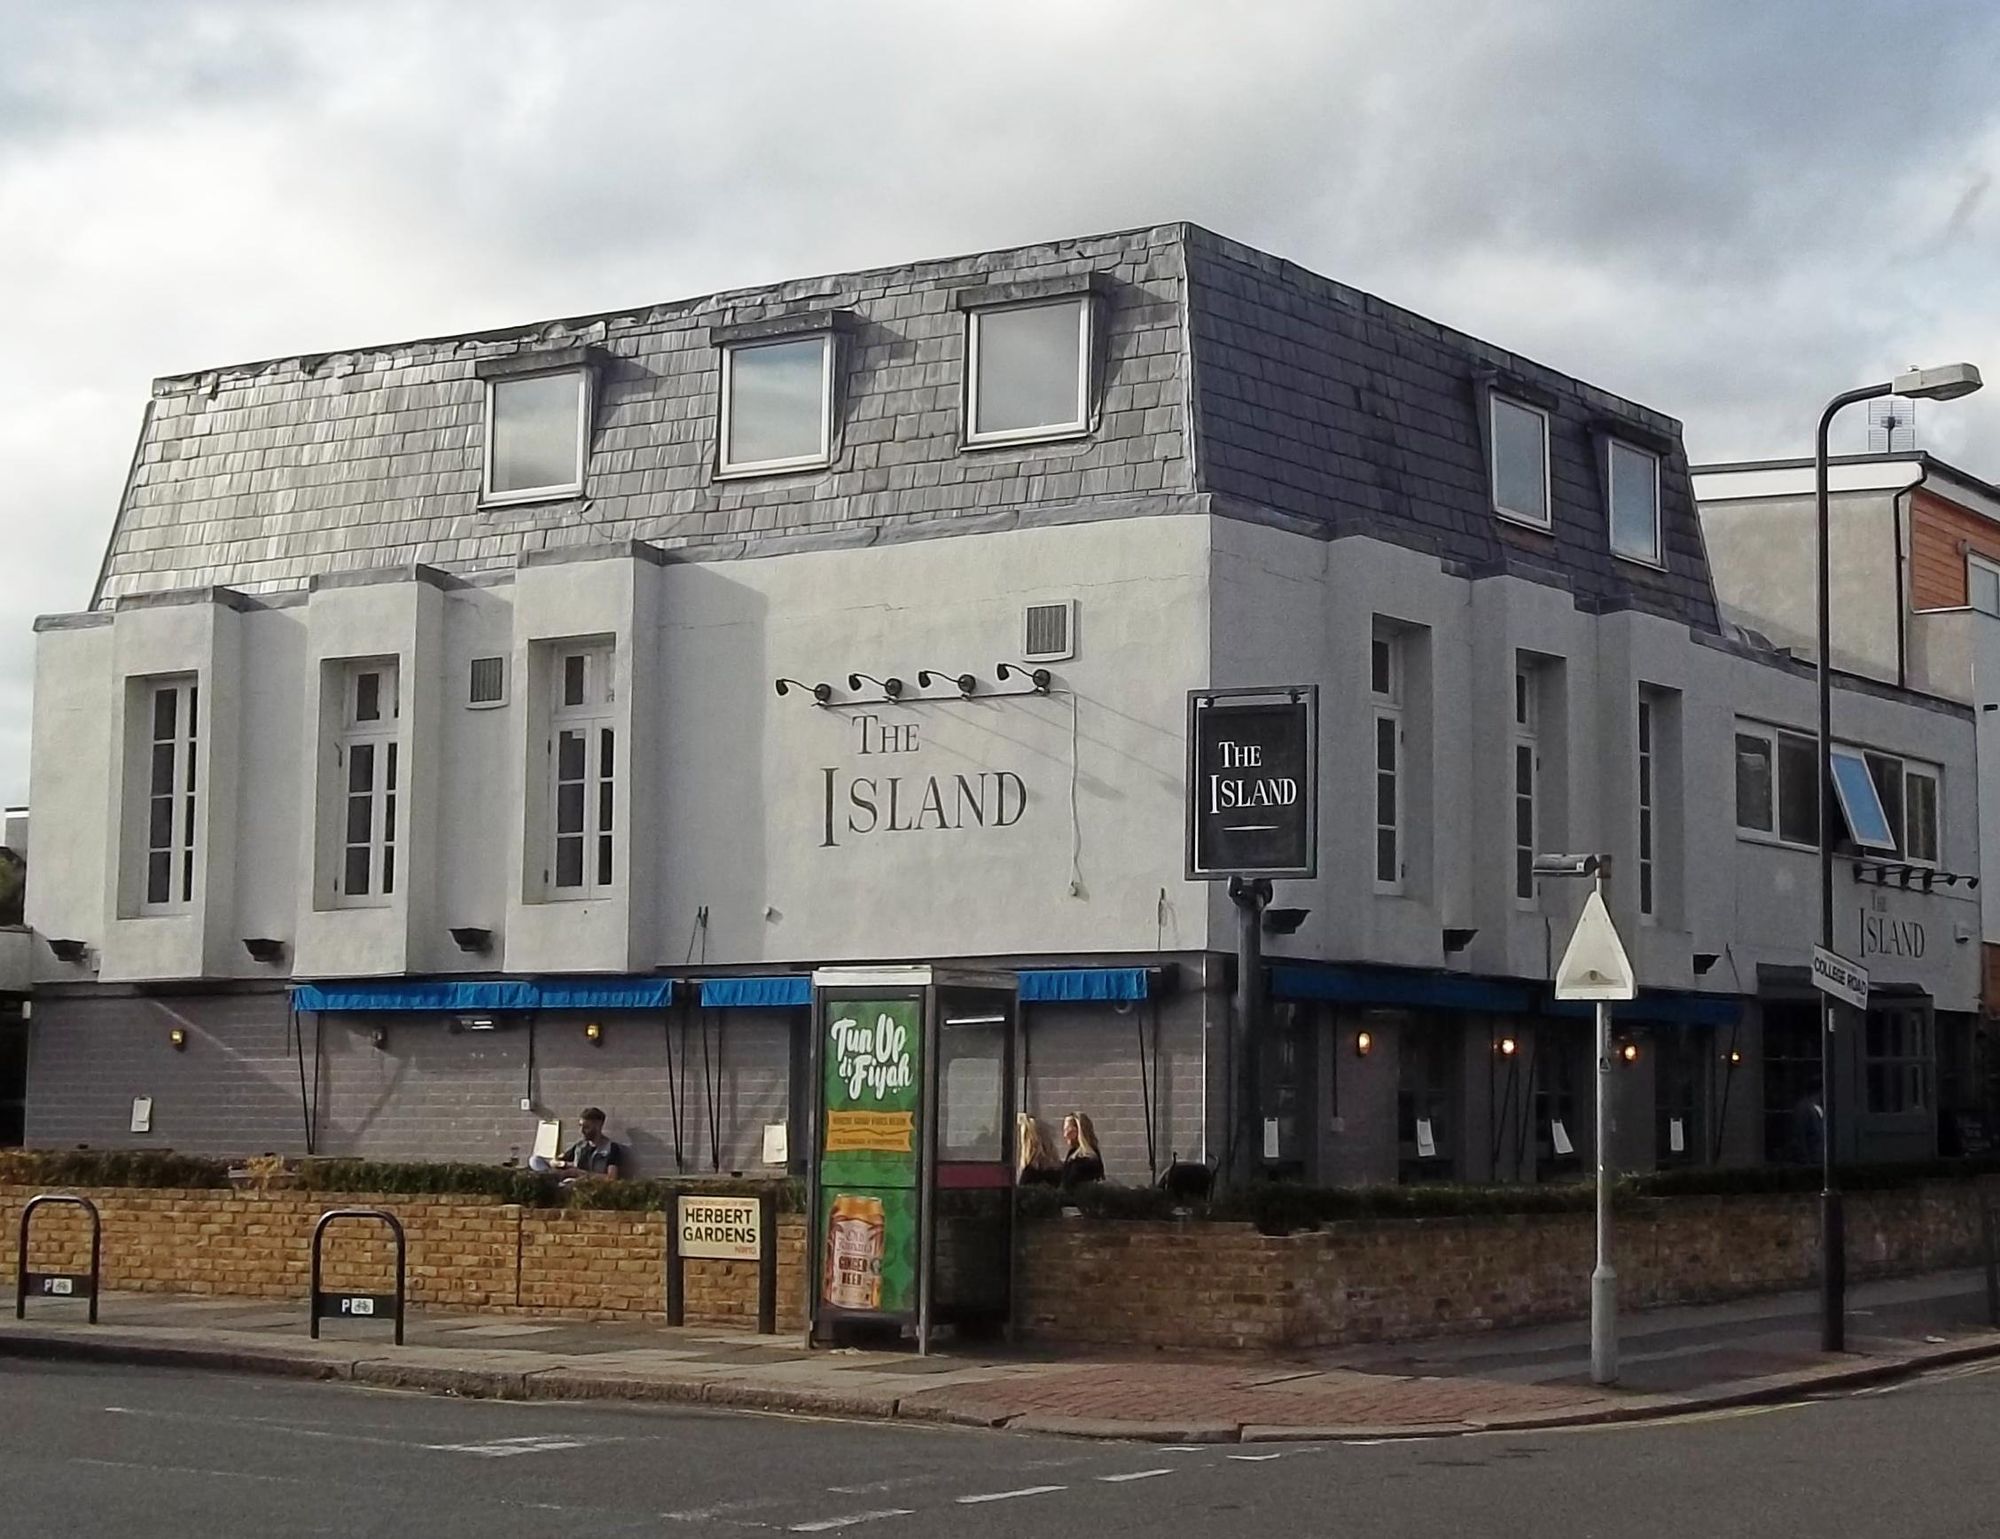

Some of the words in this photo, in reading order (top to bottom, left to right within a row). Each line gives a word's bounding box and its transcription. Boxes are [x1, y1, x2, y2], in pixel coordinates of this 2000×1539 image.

[852, 715, 920, 754] THE
[1218, 741, 1262, 768] THE
[818, 766, 1027, 847] ISLAND
[1209, 774, 1297, 814] ISLAND
[1860, 908, 1925, 958] ISLAND
[1815, 956, 1845, 986] COLLEGE
[1847, 973, 1867, 996] ROAD
[831, 1018, 874, 1062] Tun
[876, 1013, 906, 1063] Up
[849, 1053, 914, 1100] Fiyah
[683, 1226, 757, 1243] GARDENS
[685, 1207, 753, 1224] HERBERT
[44, 1279, 52, 1292] P
[841, 1272, 862, 1286] BEER
[341, 1298, 350, 1313] P
